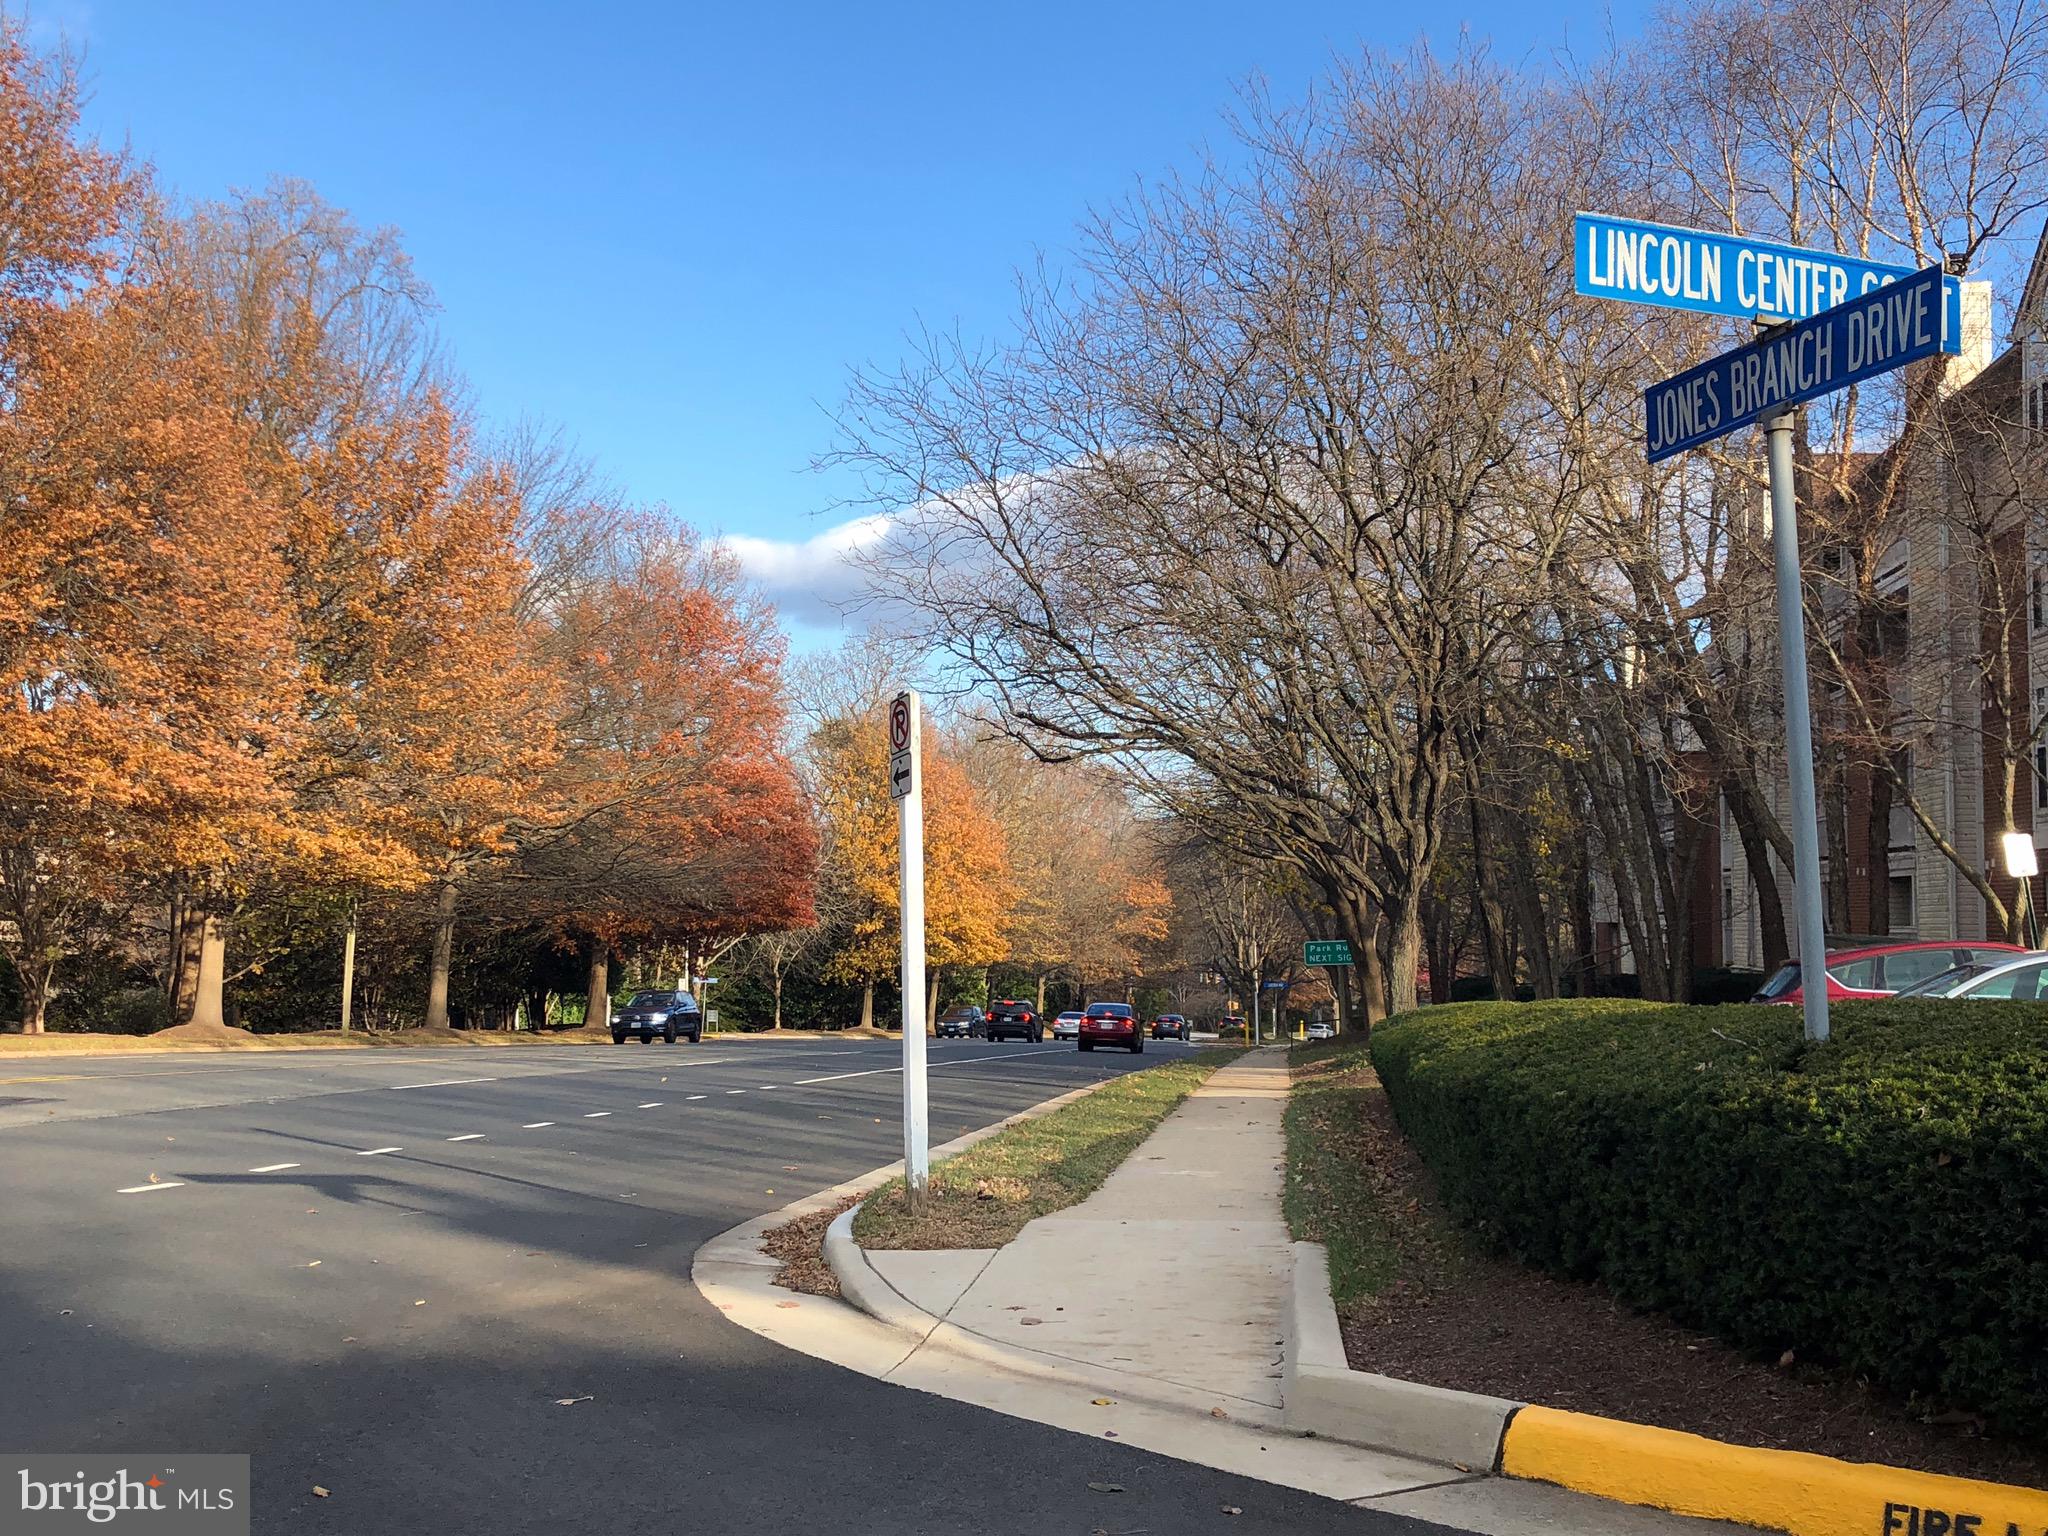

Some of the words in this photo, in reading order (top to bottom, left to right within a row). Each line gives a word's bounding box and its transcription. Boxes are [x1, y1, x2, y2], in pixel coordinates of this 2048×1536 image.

[1588, 226, 1721, 303] LINCOLN
[1737, 249, 1849, 318] CENTER
[1650, 371, 1720, 452] JONES
[1731, 322, 1833, 419] BRANCH
[1848, 281, 1932, 373] DRIVE
